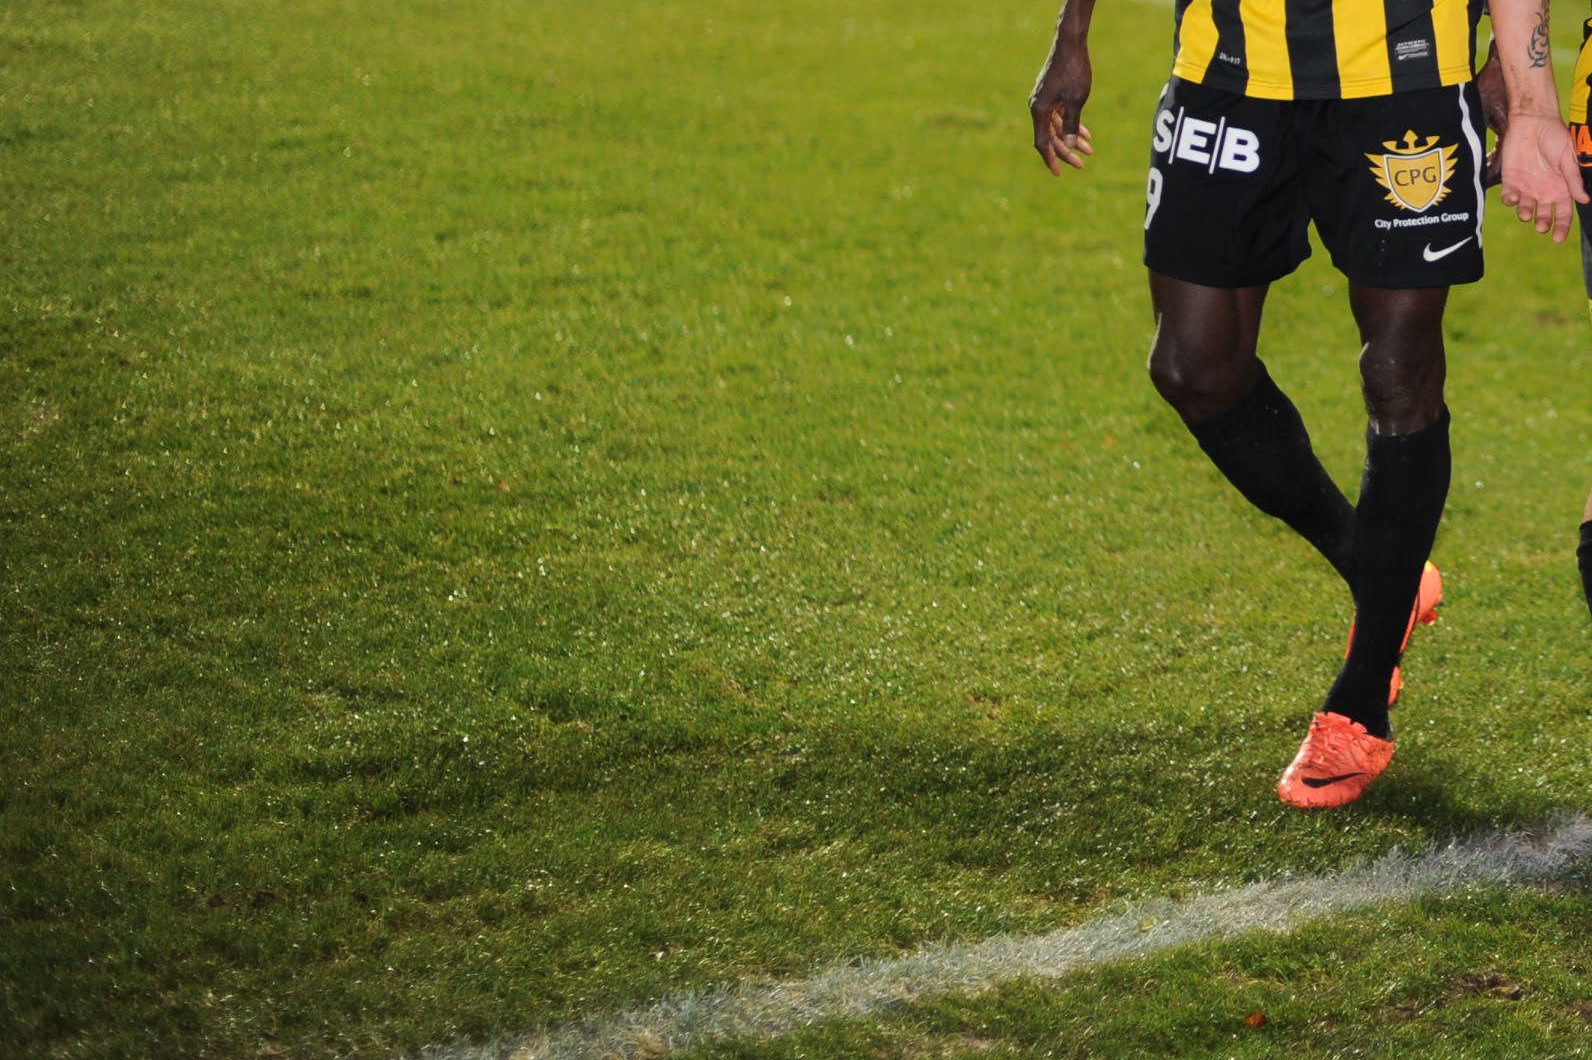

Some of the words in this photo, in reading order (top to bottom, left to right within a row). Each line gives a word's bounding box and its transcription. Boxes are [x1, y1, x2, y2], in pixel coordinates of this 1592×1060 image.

[1394, 166, 1437, 187] CPG
[1144, 166, 1164, 230] 9
[1374, 219, 1391, 230] City
[1393, 215, 1439, 227] Protection
[1441, 212, 1469, 222] Group
